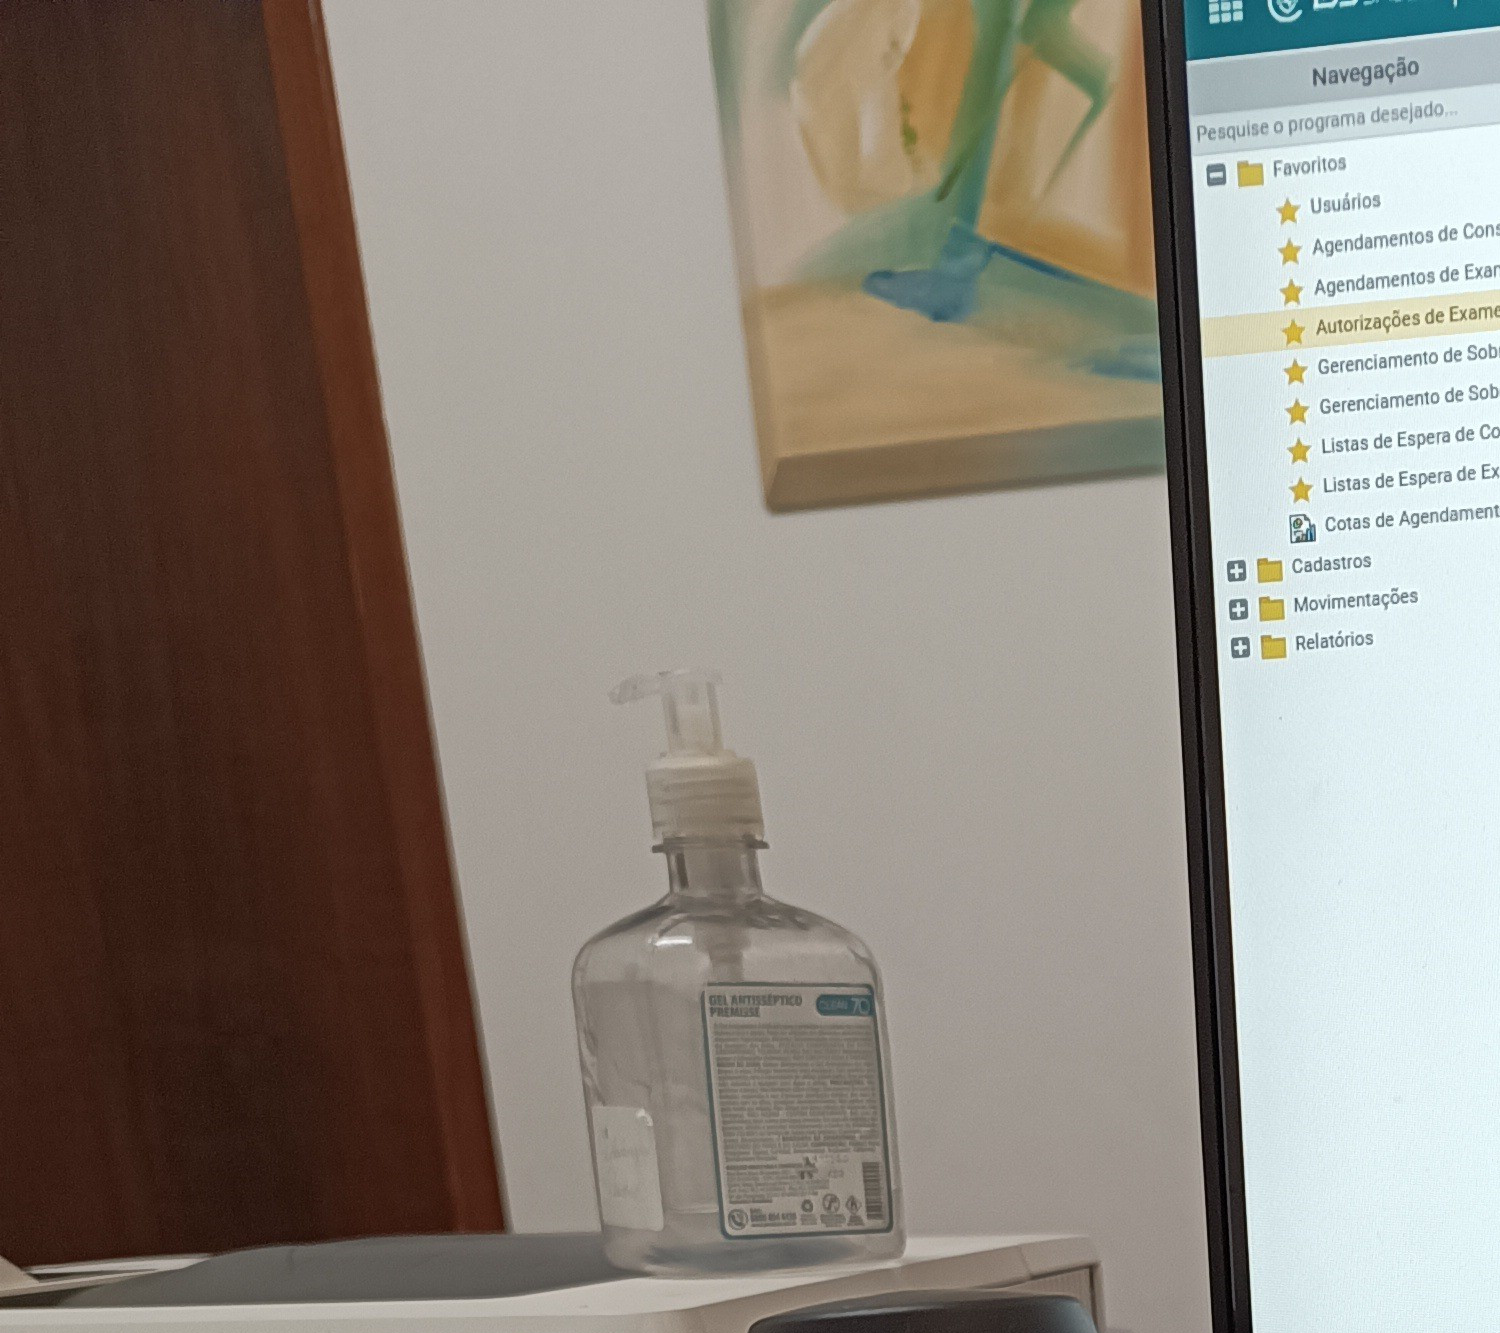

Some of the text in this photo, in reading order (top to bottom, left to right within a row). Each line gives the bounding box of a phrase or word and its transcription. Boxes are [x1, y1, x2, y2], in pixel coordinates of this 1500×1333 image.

[1312, 59, 1420, 86] Navegação
[1196, 101, 1459, 143] Pesquise o programa desejado...
[1273, 155, 1346, 178] Favoritos
[1310, 191, 1381, 214] Usuários
[1312, 229, 1434, 257] Agendamentos
[1438, 225, 1458, 241] de
[1291, 554, 1372, 575] Cadastros
[1294, 588, 1419, 613] Movimentações
[1295, 630, 1374, 651] Relatórios
